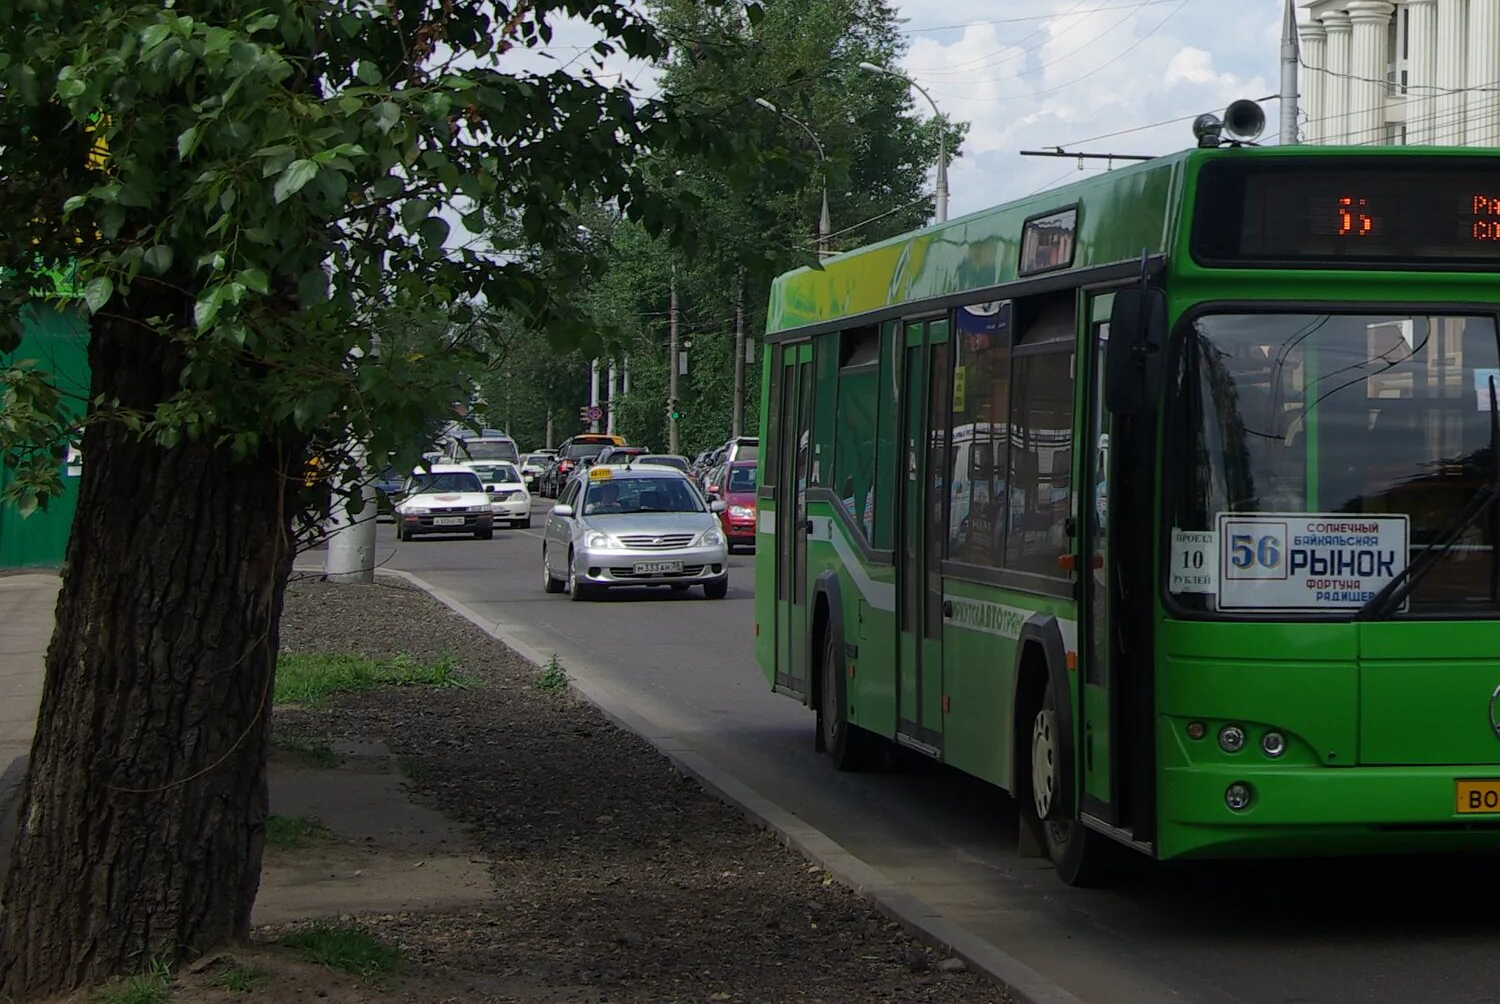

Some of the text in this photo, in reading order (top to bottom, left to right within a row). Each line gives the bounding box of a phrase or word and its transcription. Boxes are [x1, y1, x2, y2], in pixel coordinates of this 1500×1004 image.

[1307, 522, 1379, 533] СОЛНЕЧНЫЙ
[1176, 534, 1213, 543] ПРОЕЗД
[1294, 534, 1378, 546] БАЙКАЛЬСКАЯ
[1231, 534, 1281, 569] 56
[1182, 550, 1203, 569] 10
[1290, 549, 1395, 577] РЫНОК
[1174, 574, 1211, 585] РУБЛЕЙ
[1306, 579, 1361, 590] ФОРТУНА
[1469, 790, 1498, 809] ВО
